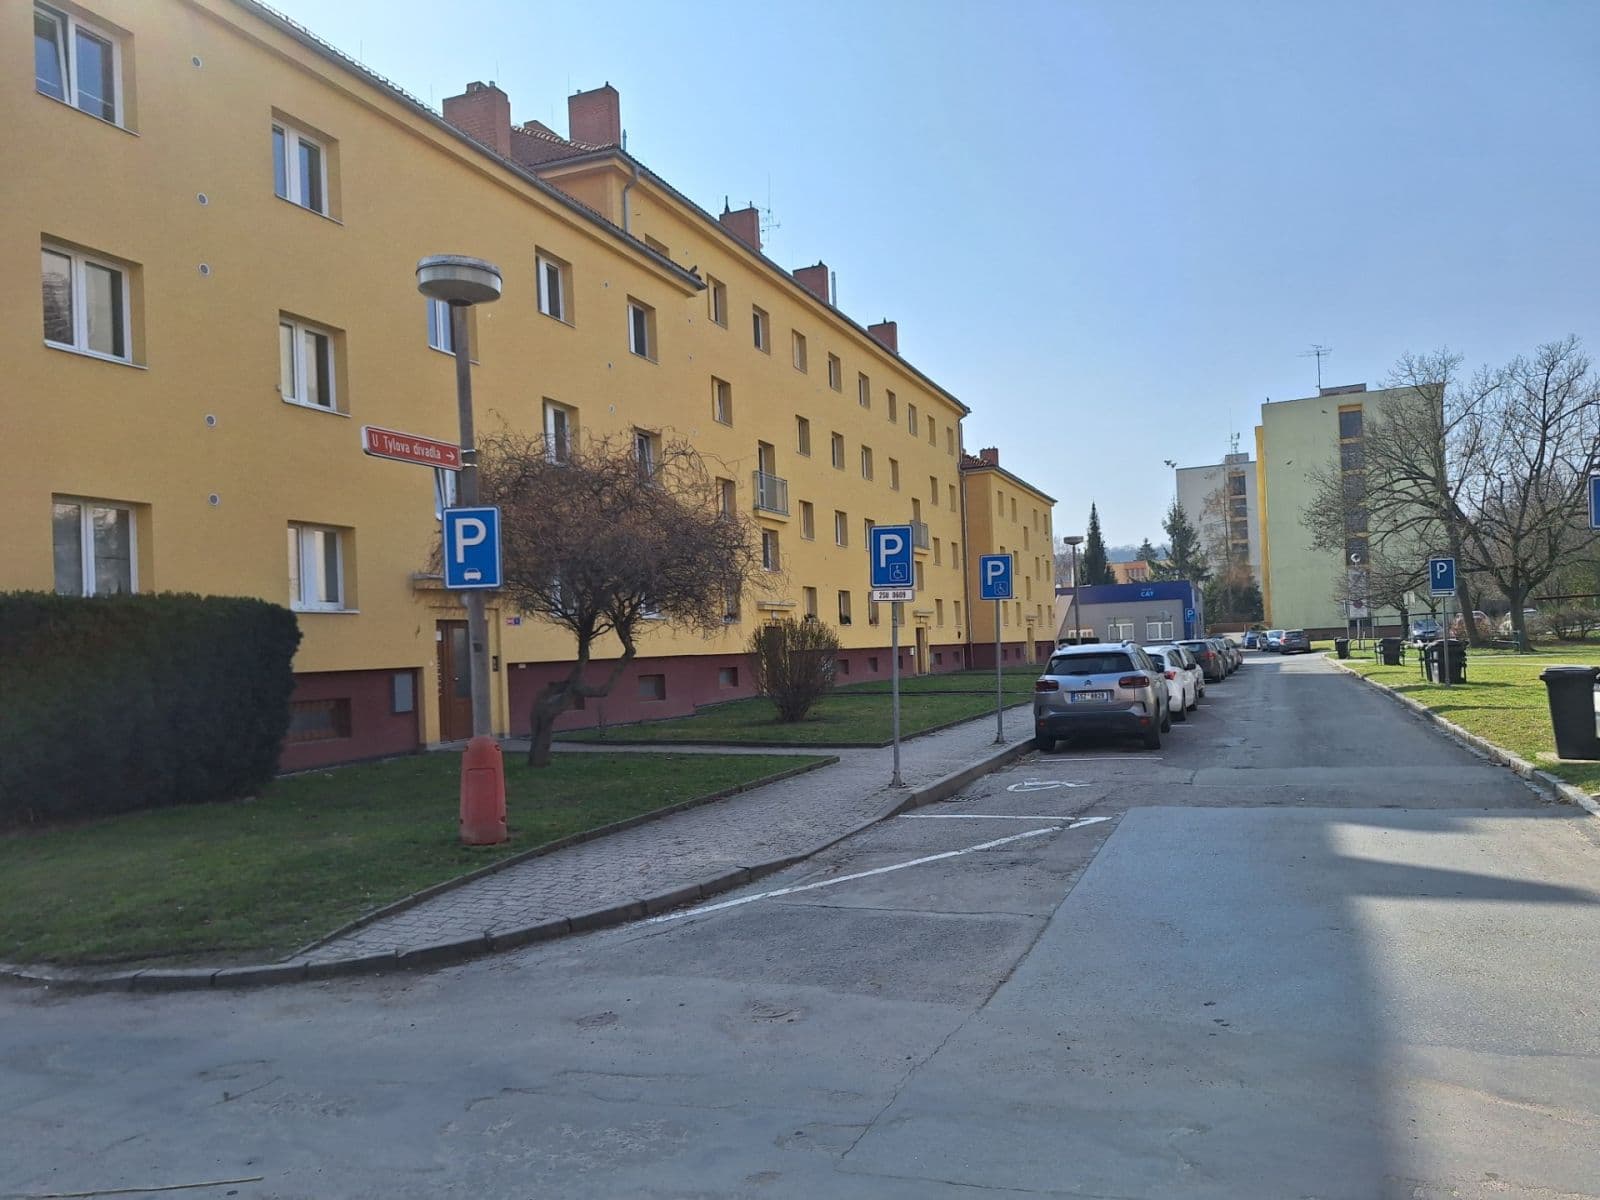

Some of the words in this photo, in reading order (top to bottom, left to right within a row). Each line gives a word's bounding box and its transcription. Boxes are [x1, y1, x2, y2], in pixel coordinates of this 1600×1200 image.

[371, 433, 379, 447] U
[383, 435, 410, 455] Tylova
[413, 444, 441, 460] divadla
[455, 518, 487, 563] P
[880, 534, 904, 568] P
[987, 560, 1005, 586] P
[1436, 562, 1447, 580] P
[1187, 610, 1194, 620] P
